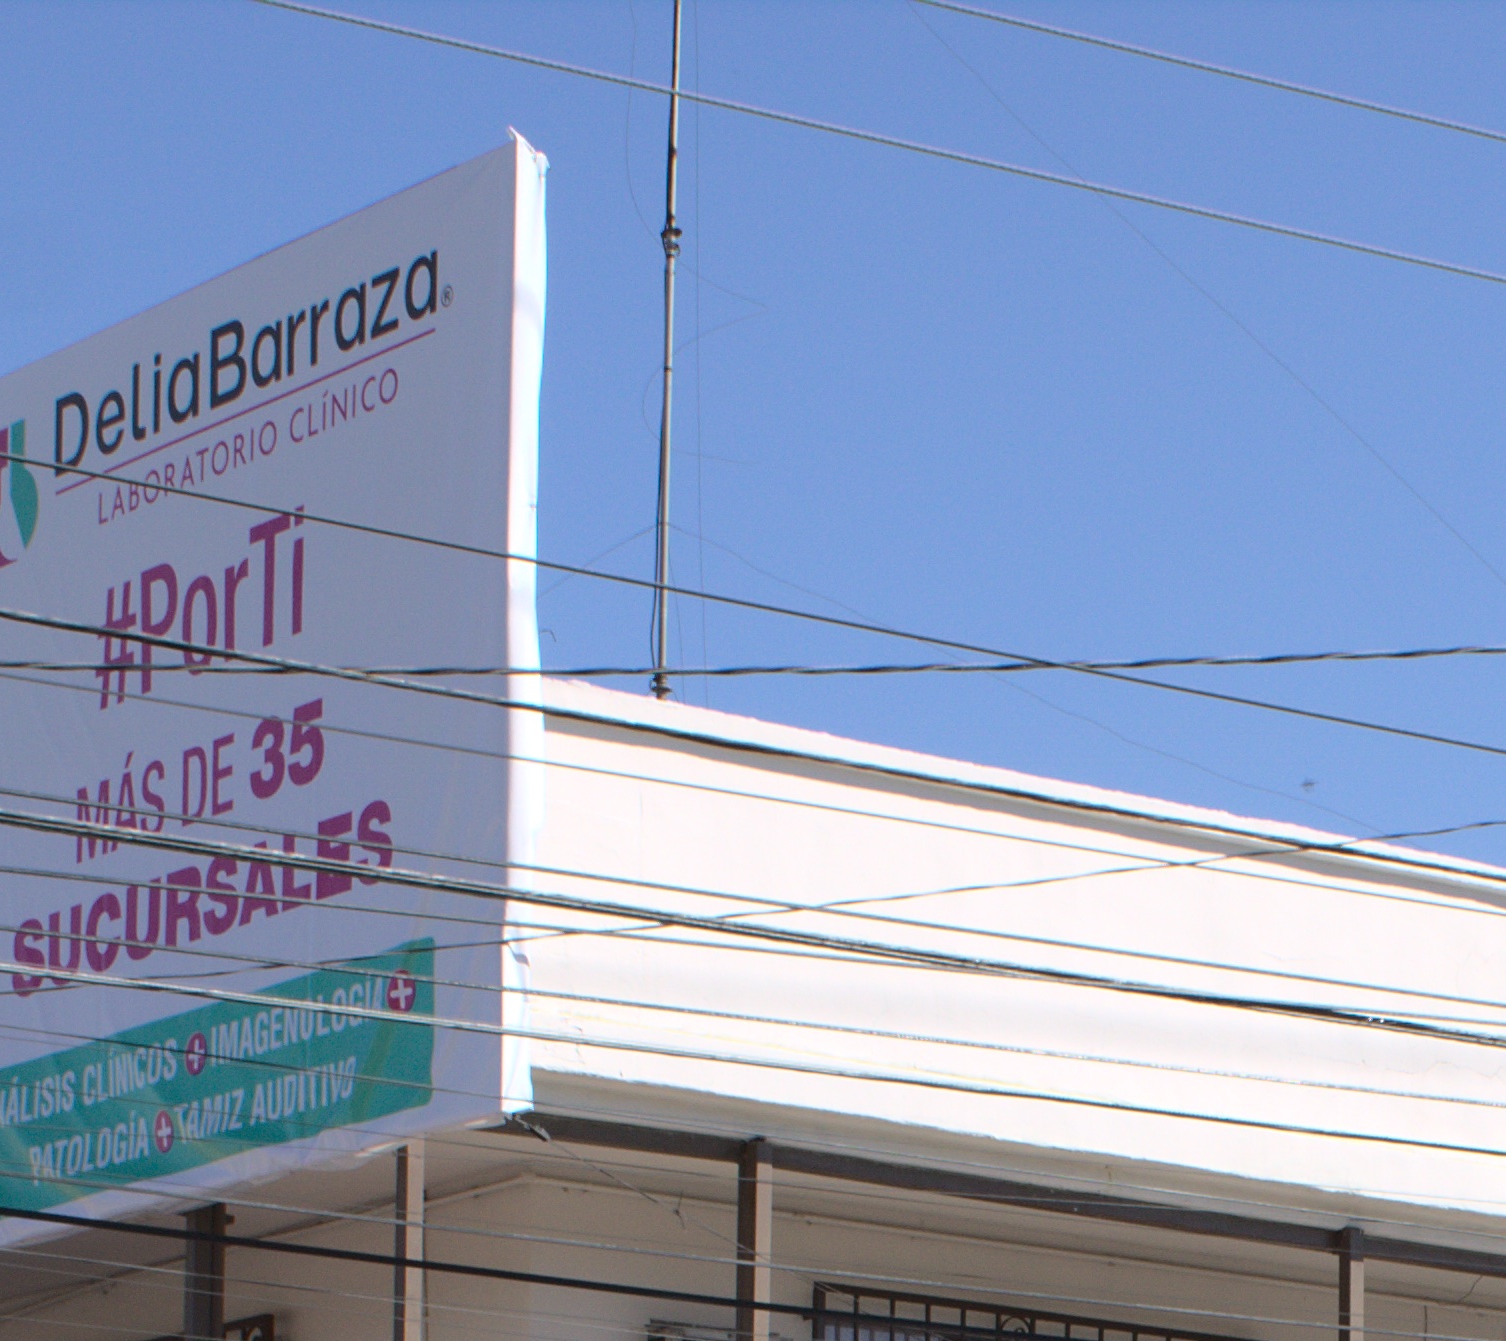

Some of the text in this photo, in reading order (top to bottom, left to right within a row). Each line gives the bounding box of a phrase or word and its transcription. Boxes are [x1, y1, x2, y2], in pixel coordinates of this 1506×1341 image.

[54, 250, 439, 477] DeliaBarraza
[97, 368, 399, 525] LABORATORIO CLÍNICO
[96, 504, 305, 709] #PorTi
[76, 698, 325, 864] MÁS DE 35
[12, 799, 393, 997] SUCURSALES
[28, 1055, 357, 1187] PATOLOGÍA TAMIZ AUDITIVO
[82, 1036, 178, 1106] CLÍNICOS
